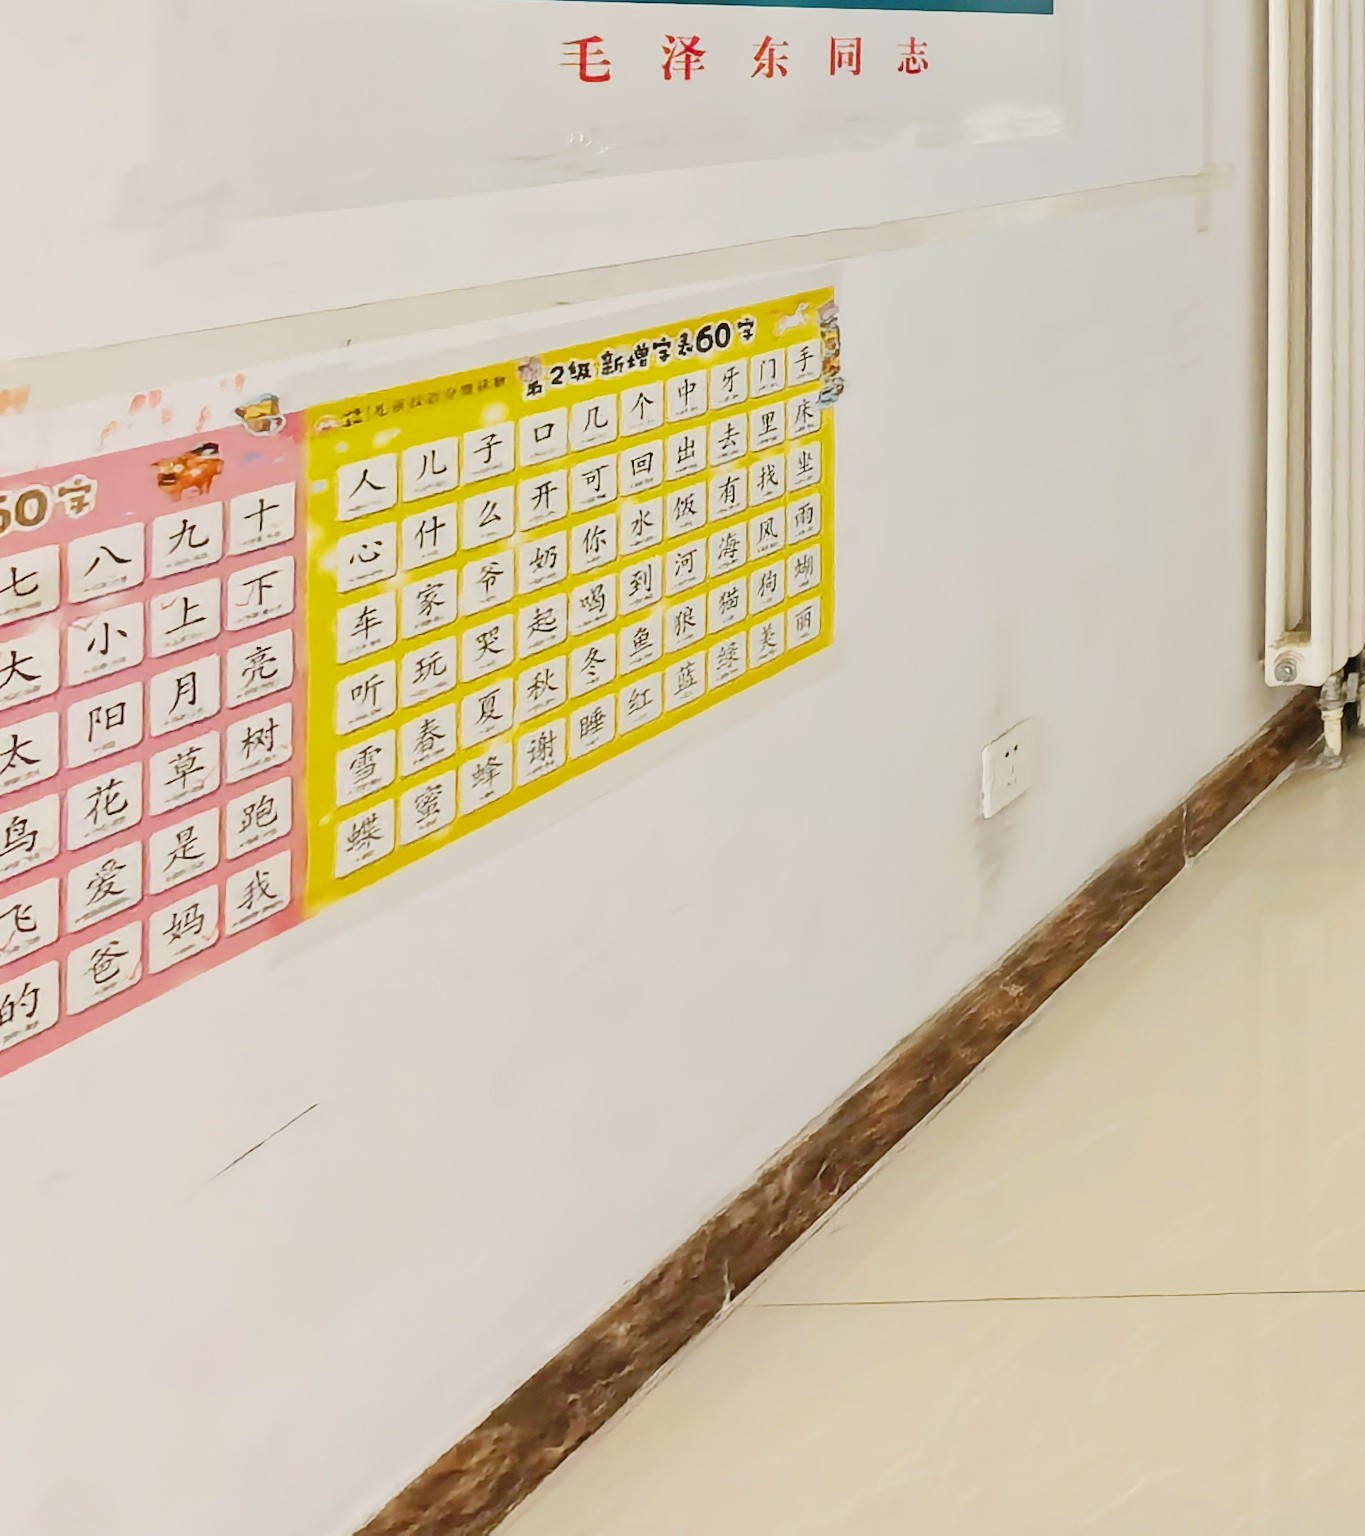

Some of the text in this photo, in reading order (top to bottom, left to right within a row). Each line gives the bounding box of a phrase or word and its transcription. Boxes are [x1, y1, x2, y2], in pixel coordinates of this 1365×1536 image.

[559, 35, 930, 83] 毛泽东同志
[348, 346, 814, 498] 人 儿 子 口 几 个 中 牙 门 手
[349, 399, 814, 565] 心 什 么 开 可 回 出 去 里 床
[0, 567, 39, 597] 七
[84, 545, 131, 578] 八
[169, 520, 210, 555] 九
[244, 499, 280, 531] 十
[351, 451, 813, 640] 车 家 爷 奶 你 水 饭 有 找 坐
[351, 504, 814, 707] 听 玩 哭 起 喝 到 河 海 风 雨
[0, 651, 41, 688] 大
[88, 623, 128, 655] 小
[165, 598, 206, 634] 上
[242, 570, 284, 606] 下
[350, 745, 383, 784] 雪
[414, 718, 446, 756] 春
[476, 688, 503, 725] 夏
[528, 669, 558, 701] 秋
[582, 647, 607, 676] 冬
[629, 627, 653, 658] 鱼
[718, 587, 739, 613] 猫
[758, 569, 778, 595] 狗
[0, 735, 40, 775] 太
[88, 702, 126, 742] 阳
[169, 672, 197, 714] 月
[241, 646, 278, 688] 亮
[0, 816, 39, 856] 鸟
[85, 778, 129, 825] 花
[164, 746, 204, 788] 草
[240, 717, 280, 758] 树
[414, 786, 444, 823] 蜜
[471, 756, 505, 790] 蜂
[528, 731, 557, 765] 谢
[579, 707, 607, 739] 睡
[628, 689, 653, 717] 红
[674, 662, 697, 695] 蓝
[795, 606, 813, 632] 丽
[0, 903, 37, 933] 飞
[86, 858, 126, 906] 爱
[163, 825, 206, 872] 是
[238, 794, 278, 834] 跑
[0, 983, 40, 1026] 的
[85, 940, 129, 984] 爸
[162, 903, 205, 944] 妈
[237, 869, 278, 910] 我
